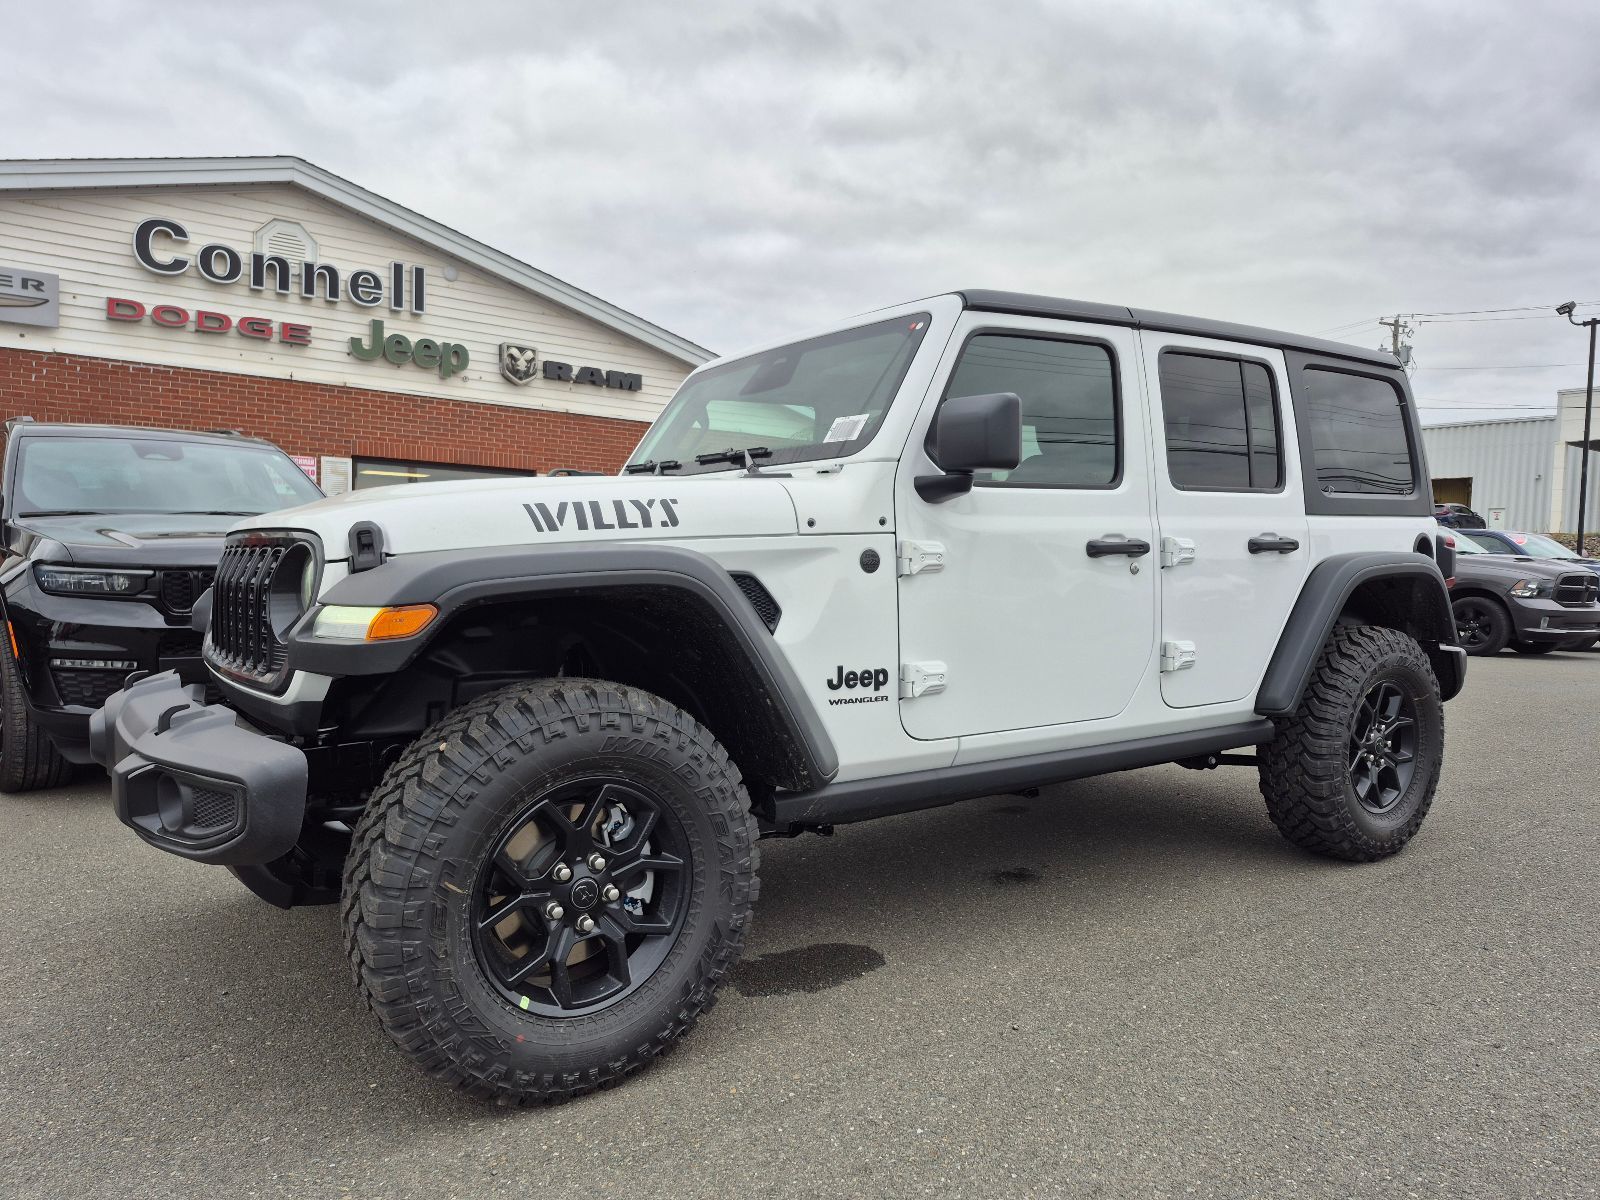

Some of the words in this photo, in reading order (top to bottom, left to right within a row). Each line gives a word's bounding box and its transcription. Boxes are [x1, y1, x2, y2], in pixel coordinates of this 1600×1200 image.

[132, 216, 427, 315] Connell
[106, 296, 312, 345] DODGE
[349, 318, 470, 379] Jeep
[542, 359, 643, 392] RAM
[522, 498, 680, 533] WILLYS
[826, 664, 889, 692] Jeep
[828, 695, 889, 706] WRANGLER
